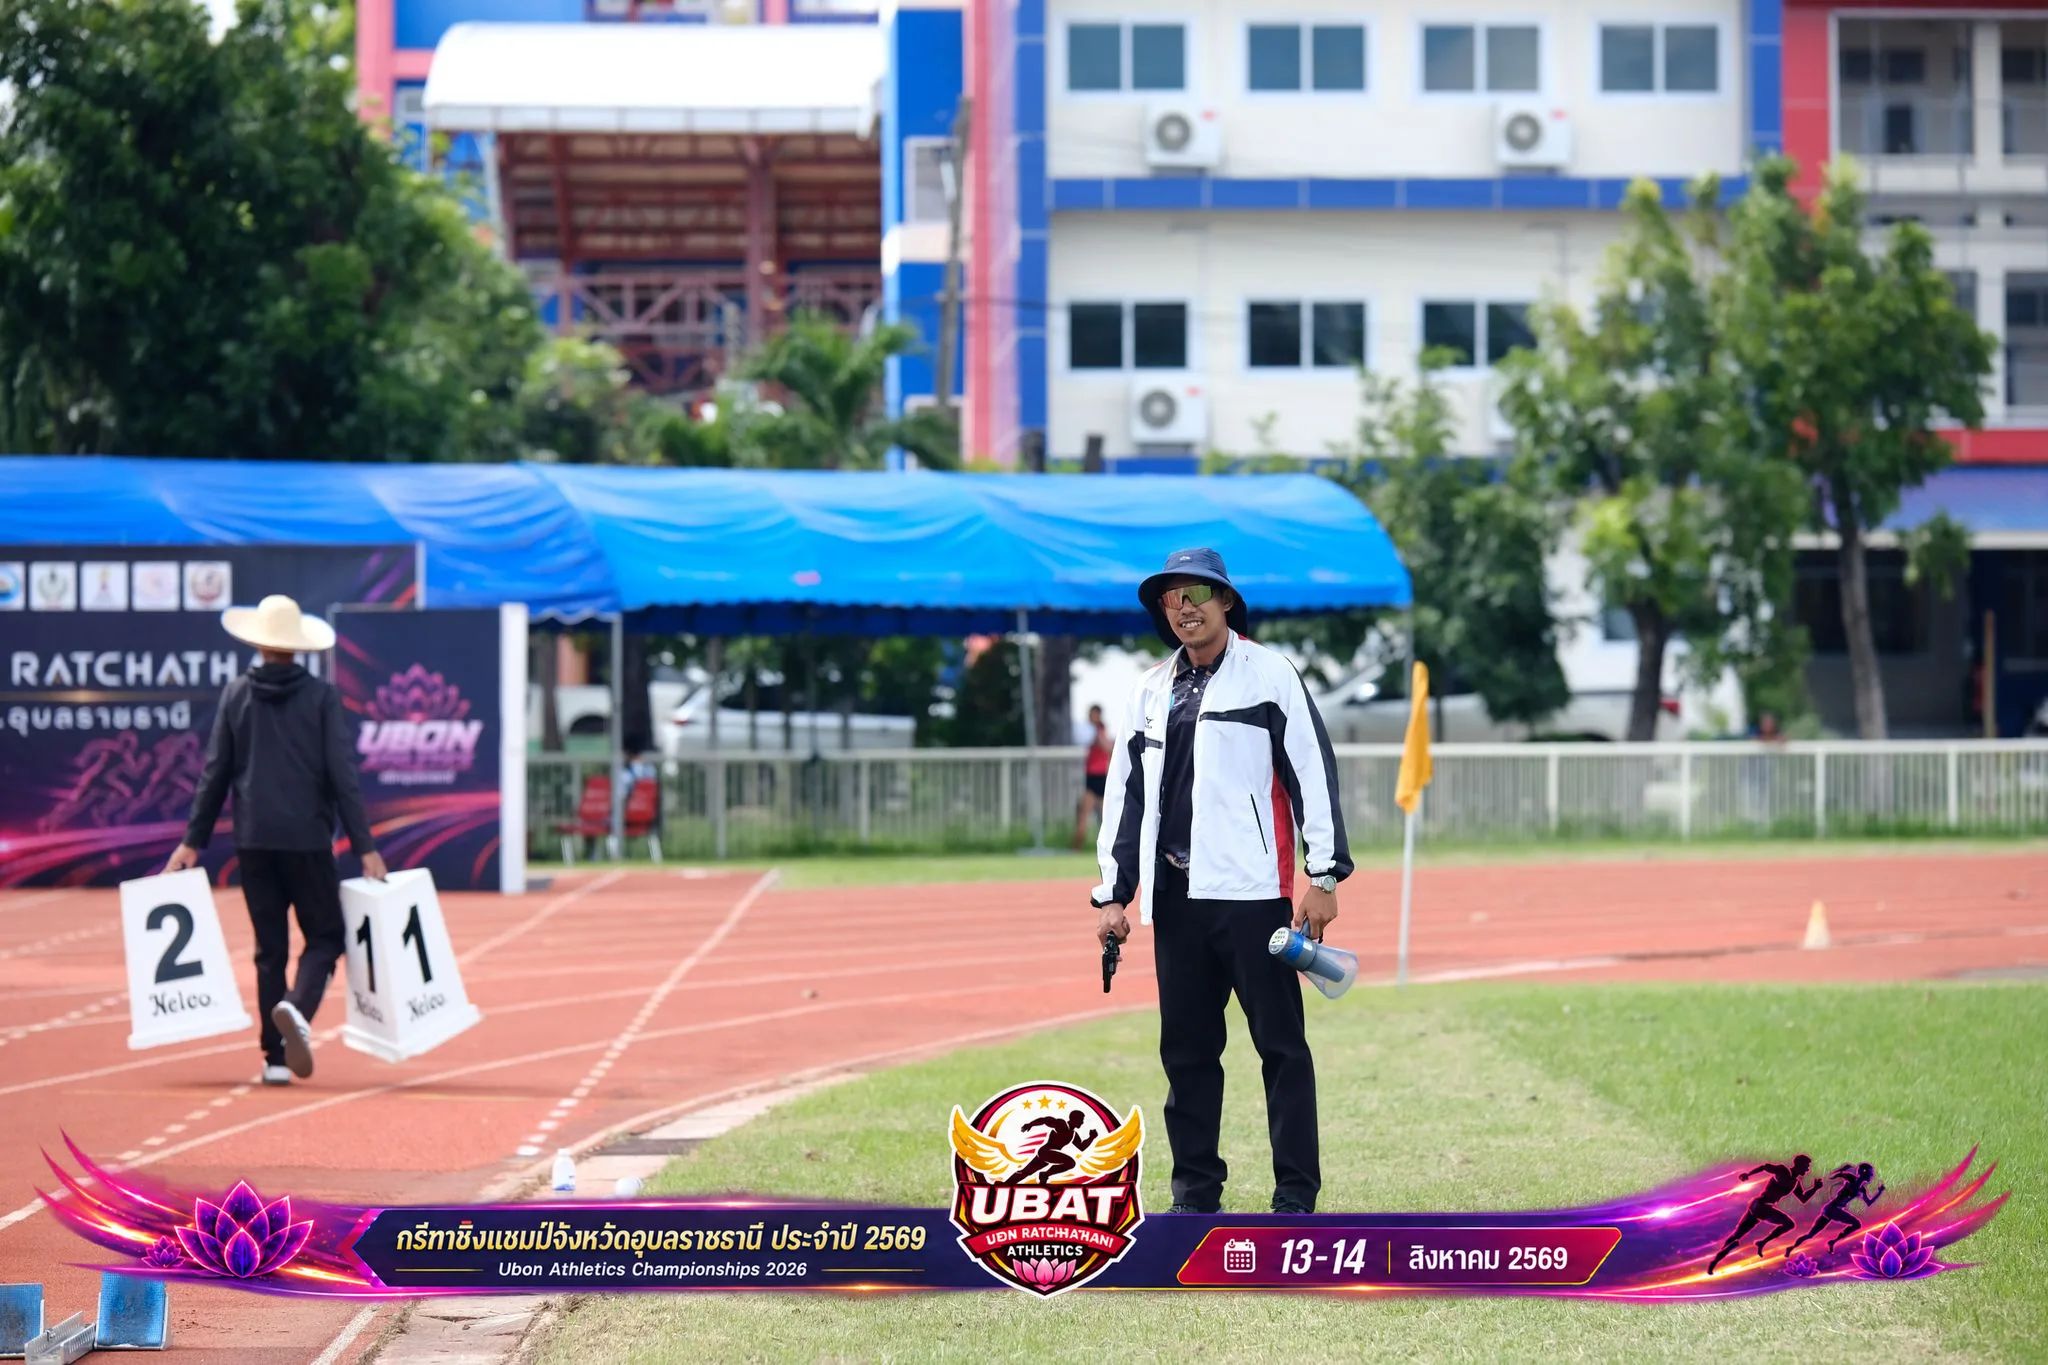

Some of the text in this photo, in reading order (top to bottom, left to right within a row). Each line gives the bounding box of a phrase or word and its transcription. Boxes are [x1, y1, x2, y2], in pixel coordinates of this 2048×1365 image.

[356, 719, 484, 755] UBON
[145, 902, 204, 985] 2
[356, 914, 377, 994] 1
[401, 904, 433, 984] 1
